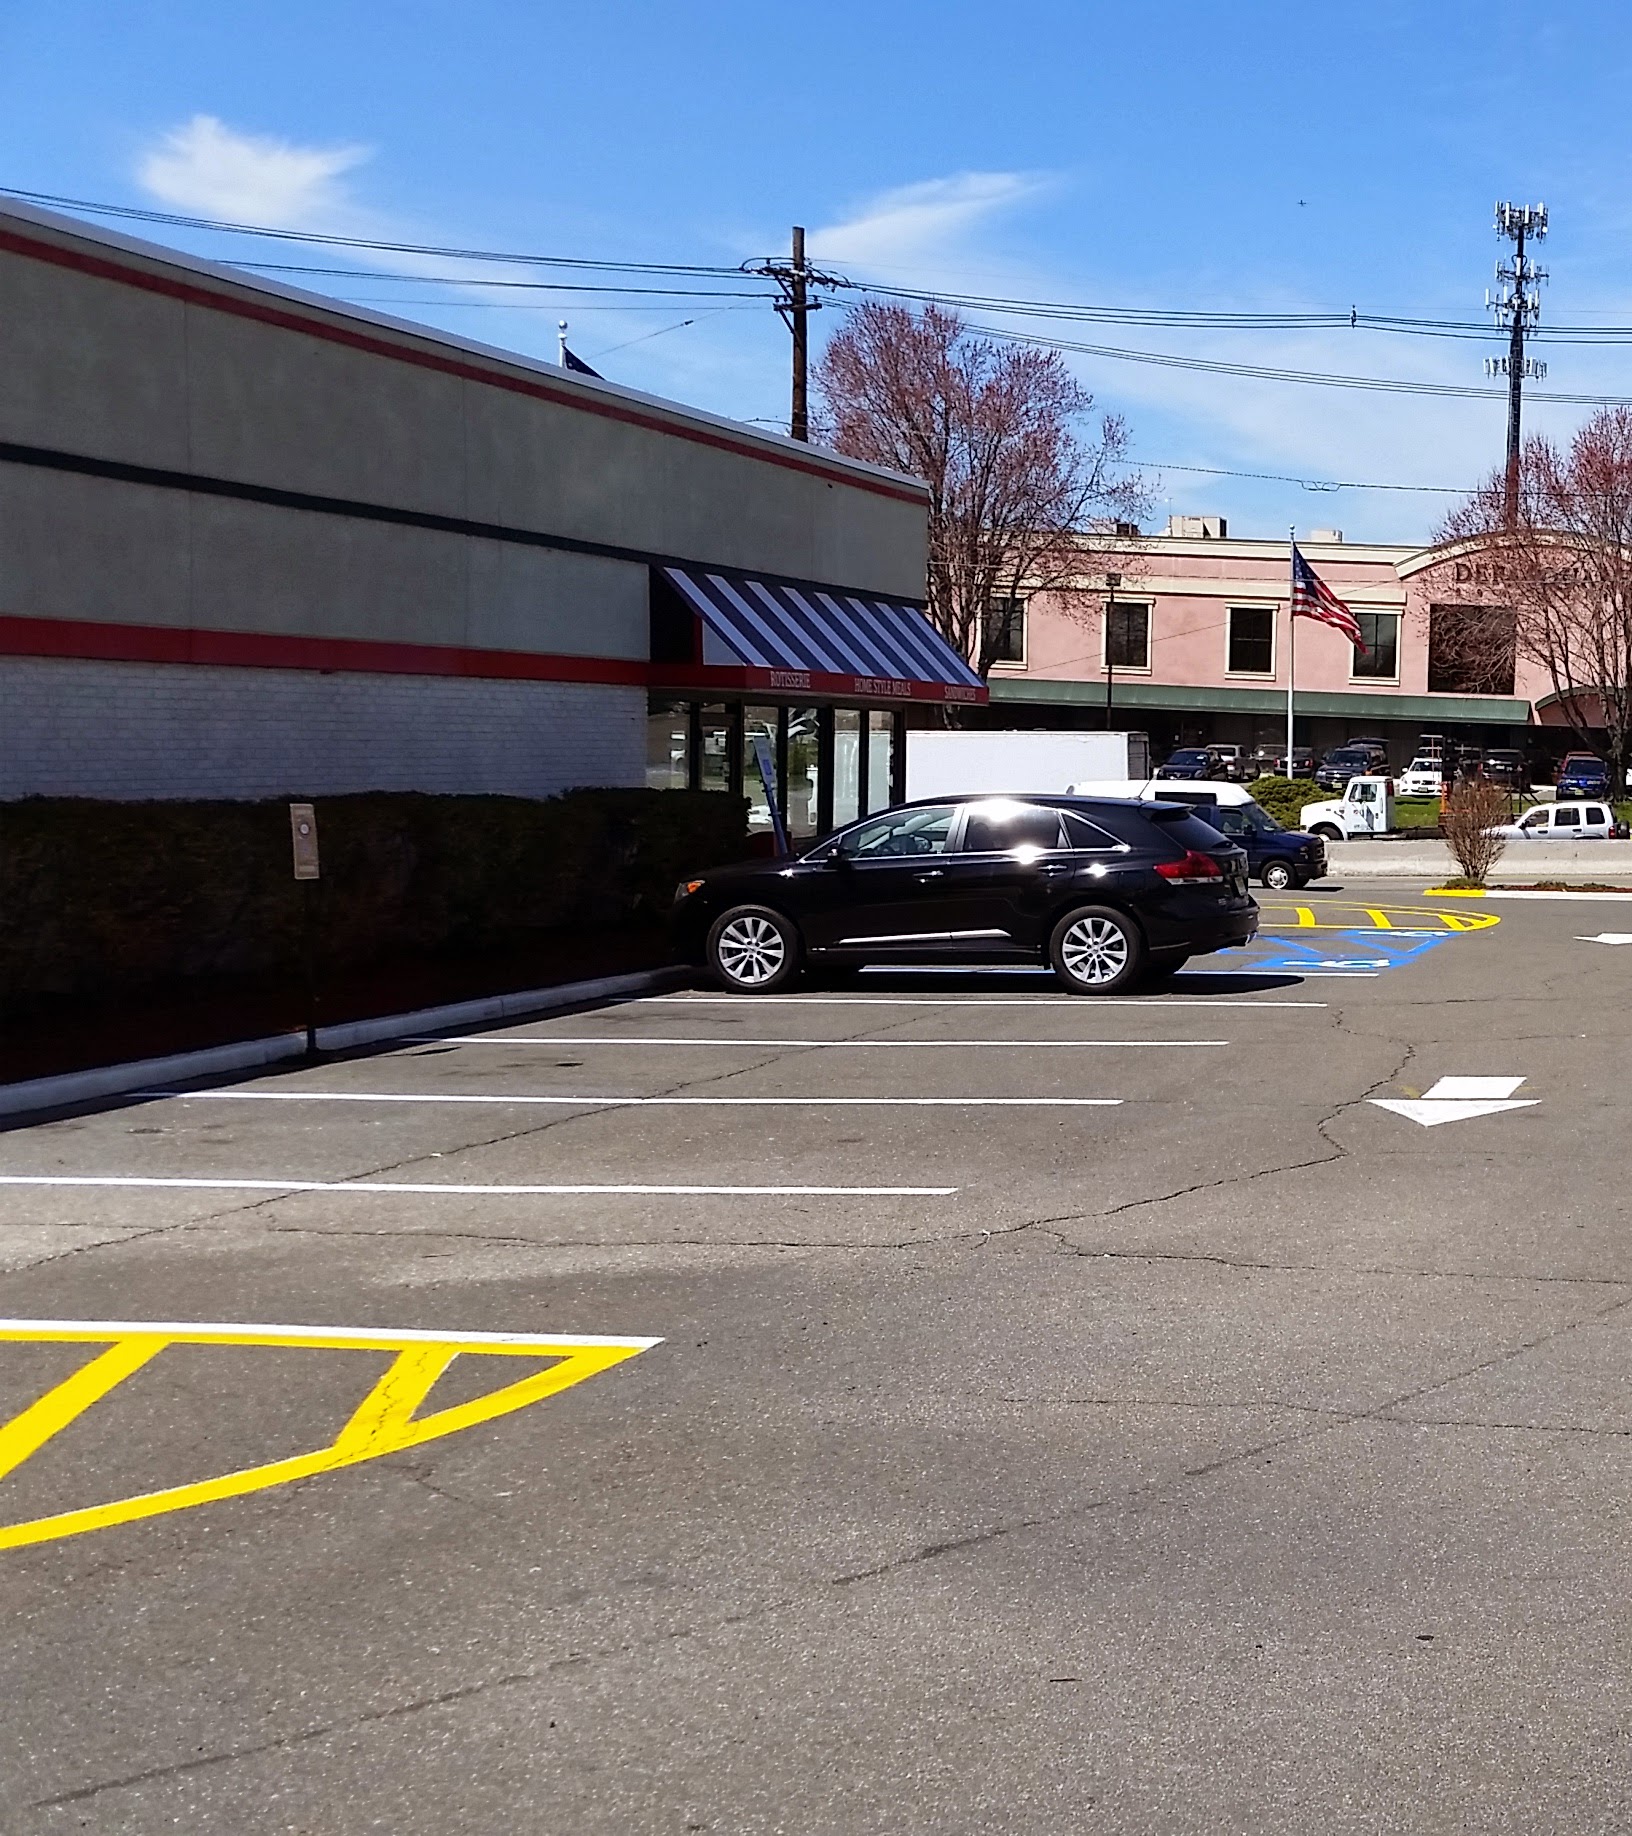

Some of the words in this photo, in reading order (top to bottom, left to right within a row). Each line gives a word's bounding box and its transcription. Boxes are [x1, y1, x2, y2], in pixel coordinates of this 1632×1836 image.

[770, 670, 811, 688] ROTISSERIE
[854, 678, 873, 693] HOME
[873, 679, 891, 694] STYLE
[891, 680, 911, 696] MEALS
[944, 686, 976, 700] SANDWICHES
